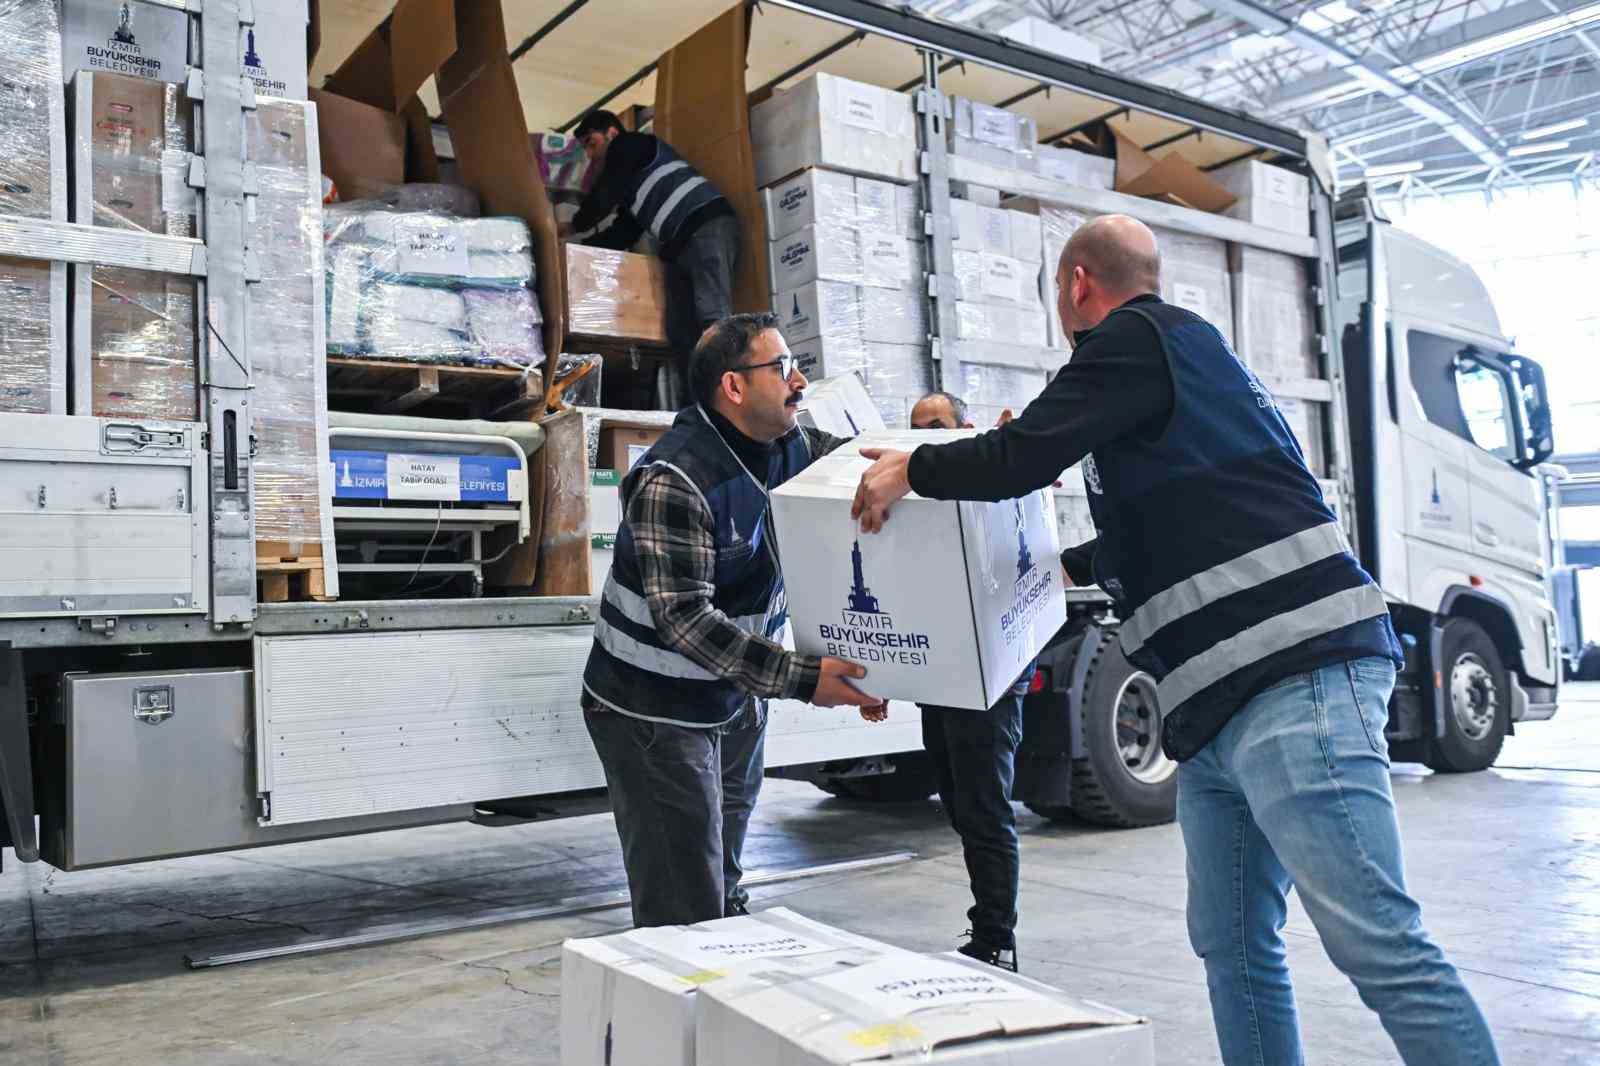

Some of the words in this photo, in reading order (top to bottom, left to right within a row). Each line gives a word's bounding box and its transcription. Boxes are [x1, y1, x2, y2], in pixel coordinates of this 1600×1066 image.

[87, 46, 161, 70] BÜYÜKŞEHİR
[90, 57, 159, 78] BELEDİYESİ
[410, 464, 436, 472] HATAY
[354, 474, 385, 488] İZMİR
[459, 481, 505, 492] ELEDİYESİ
[1015, 566, 1039, 597] İZMİR
[1001, 570, 1052, 632] BÜYÜKŞEHİR
[842, 611, 893, 630] İZMİR
[819, 623, 931, 650] BÜYÜKŞEHİR
[827, 642, 928, 666] BELEDİYESİ
